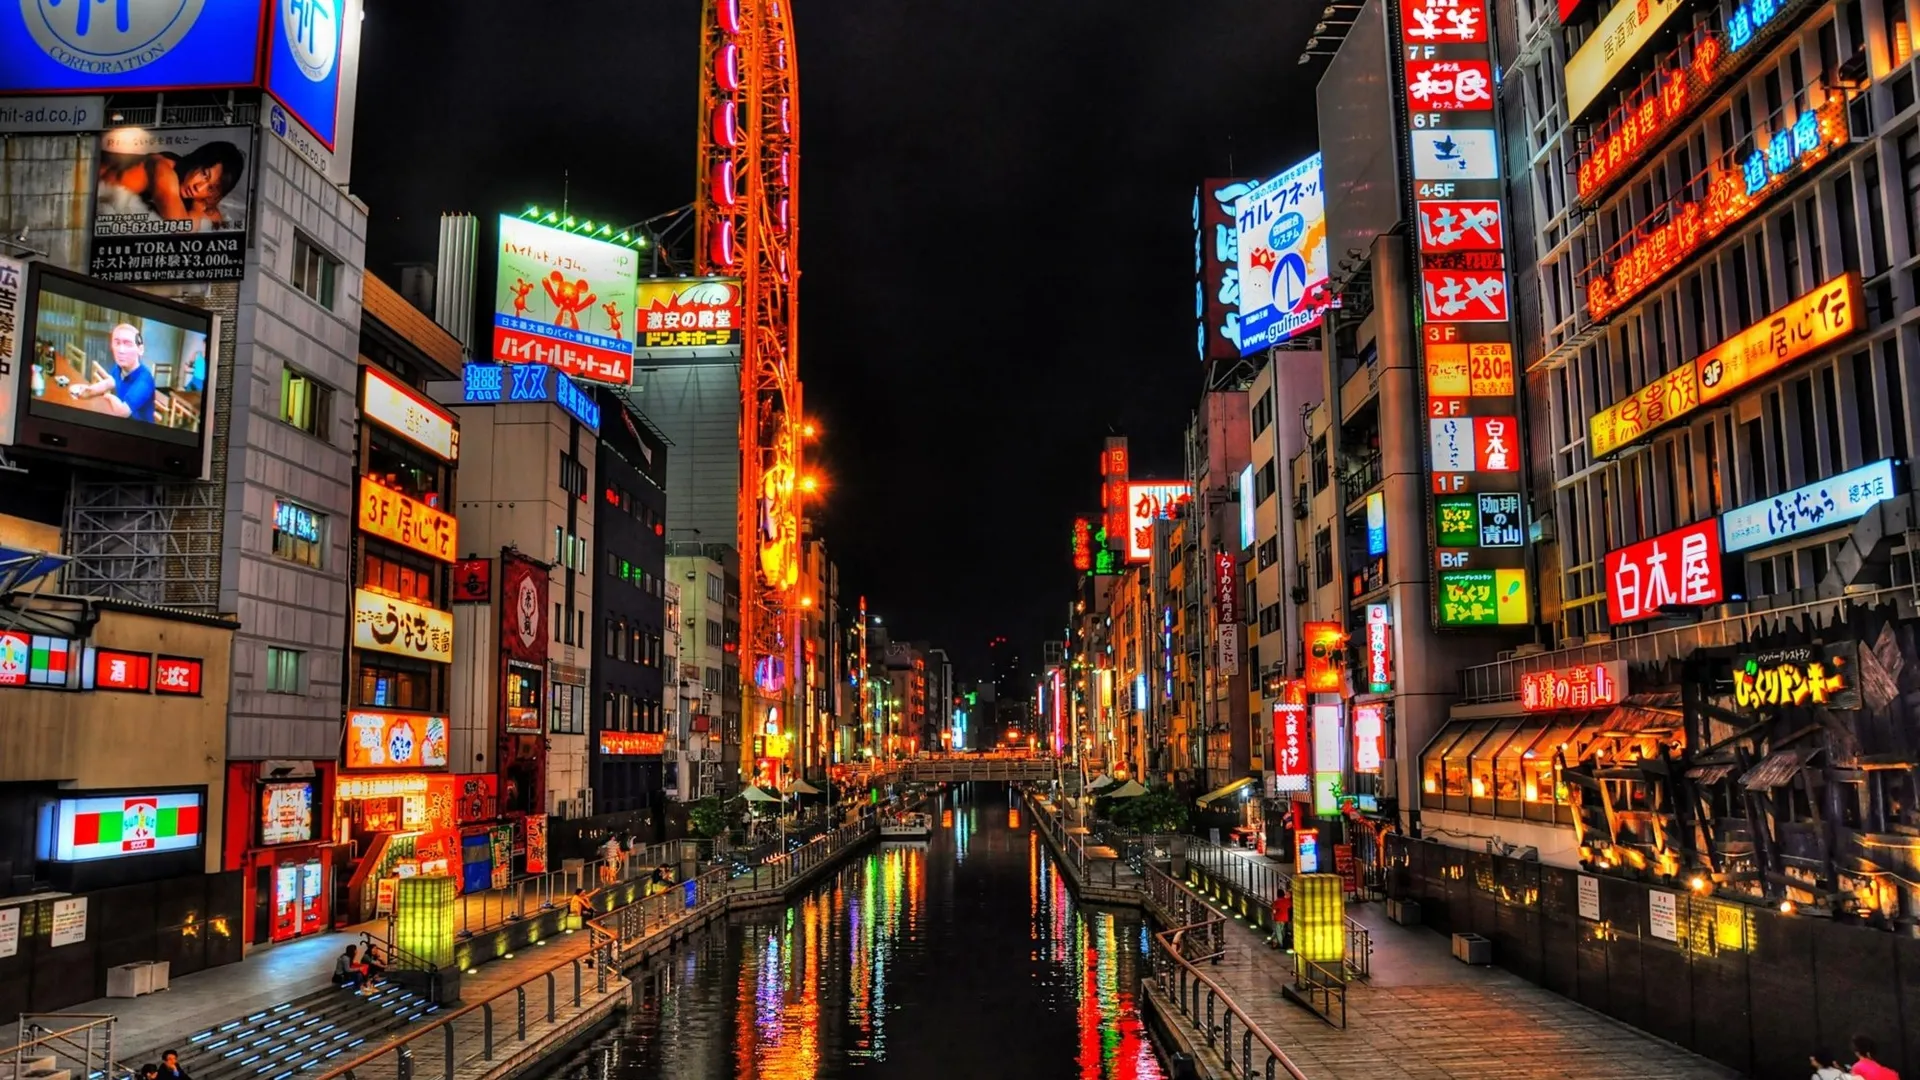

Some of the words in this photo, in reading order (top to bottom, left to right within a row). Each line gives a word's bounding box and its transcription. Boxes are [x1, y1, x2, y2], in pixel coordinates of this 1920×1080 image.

[50, 43, 166, 73] CORPORATION
[1409, 69, 1490, 102] 和民
[0, 106, 87, 125] hit-ad.co.jp
[1432, 101, 1465, 109] わたみ
[1239, 168, 1323, 233] ガルフネッ
[98, 226, 110, 234] TEL
[112, 221, 192, 234] 06-6214-7845
[1421, 207, 1499, 246] はや
[134, 242, 175, 254] TORA
[180, 240, 203, 252] NO
[1425, 276, 1504, 316] はや
[647, 309, 732, 329] 激安の殿堂
[501, 337, 625, 378] バイトルドットコム
[1474, 345, 1507, 356] 全品
[1472, 357, 1513, 380] 280円
[1704, 360, 1722, 388] 3F
[1484, 419, 1510, 470] 白木屋
[368, 495, 390, 527] 3F
[1442, 508, 1471, 522] びっくり
[1482, 496, 1518, 514] 珈琲
[1442, 521, 1473, 532] ドンキー
[1493, 513, 1507, 525] の
[1483, 525, 1520, 544] 青山
[1440, 552, 1469, 568] B1F
[1615, 533, 1714, 618] 白木屋
[1446, 583, 1491, 604] びっくり
[1445, 603, 1494, 621] ドンキー
[372, 603, 429, 652] うなぎ
[1758, 648, 1810, 662] ハンバーグレストラン
[110, 660, 127, 683] 酒
[158, 666, 189, 687] たばこ
[1523, 666, 1611, 709] 珈琲の青山
[1733, 660, 1844, 709] びっくりドンキー
